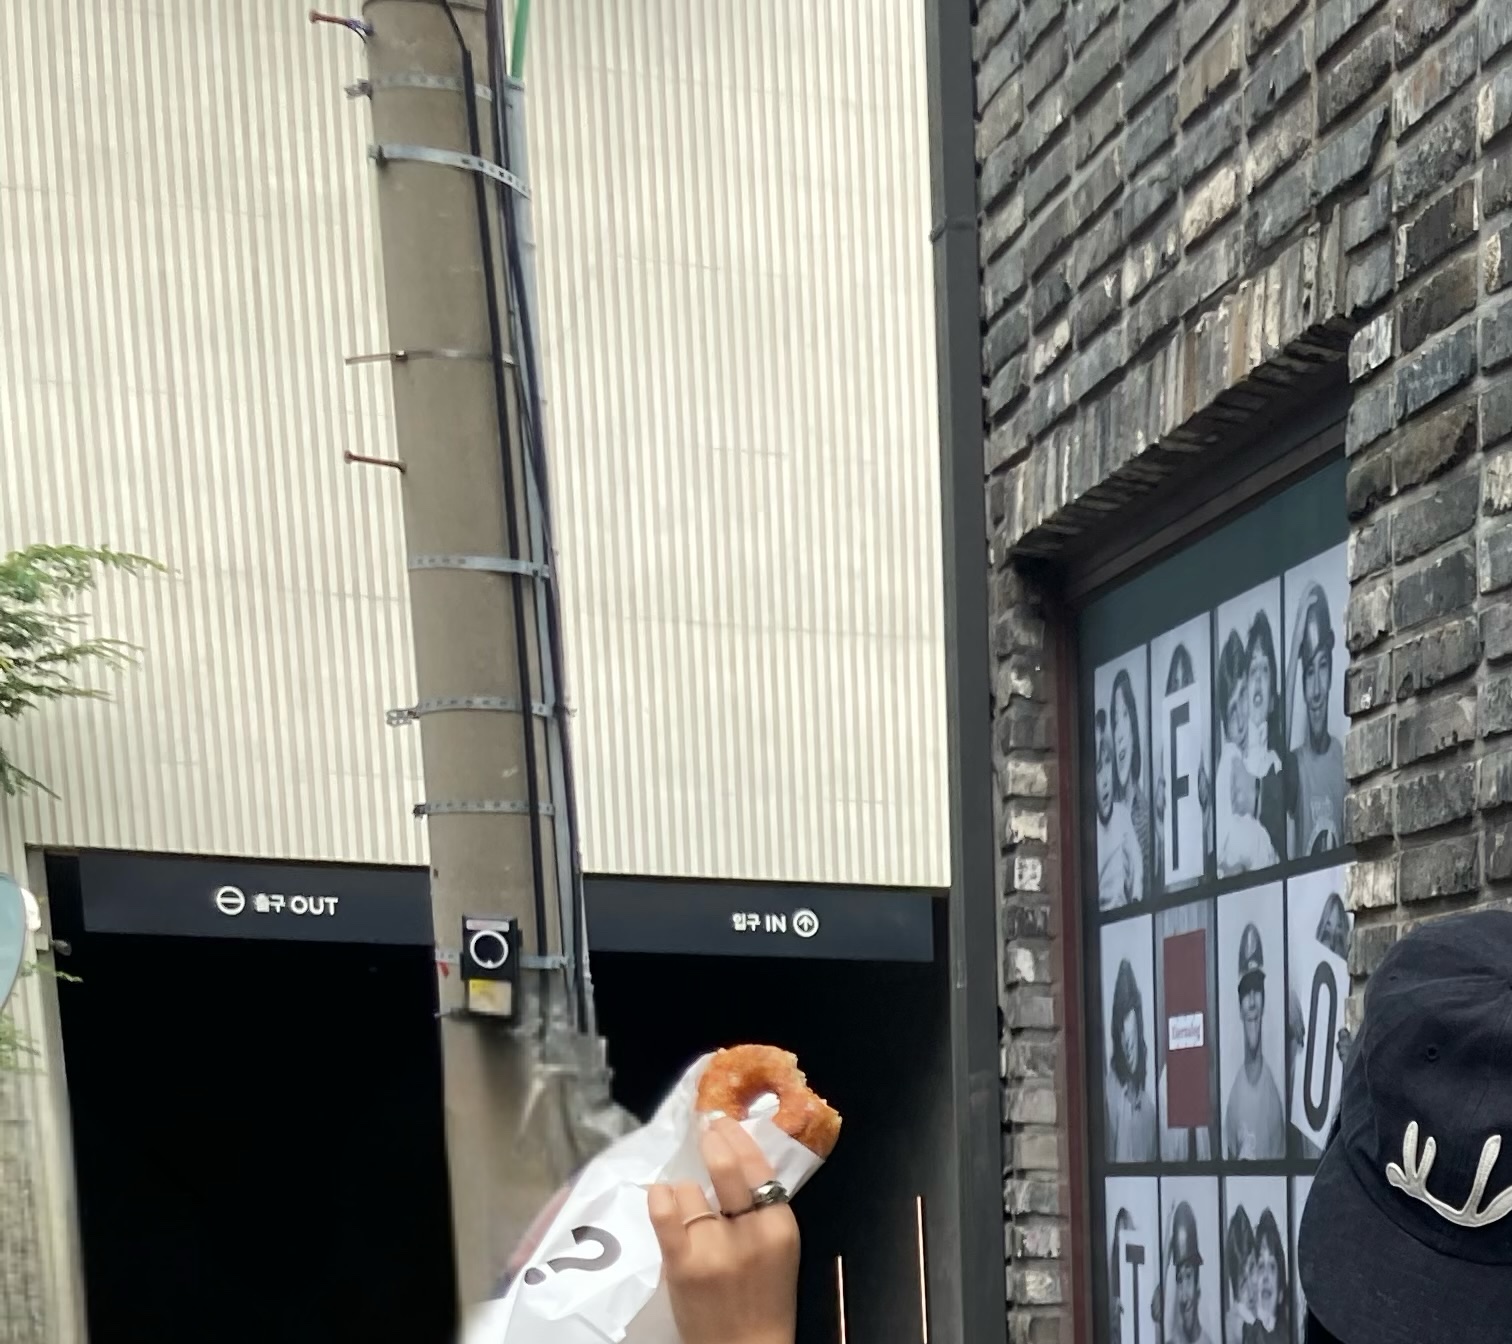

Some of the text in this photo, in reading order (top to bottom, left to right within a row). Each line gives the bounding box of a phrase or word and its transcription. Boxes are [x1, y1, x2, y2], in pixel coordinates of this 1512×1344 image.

[1170, 701, 1190, 871] F
[290, 895, 339, 916] OUT
[732, 912, 787, 933] 입구 IN
[524, 1225, 622, 1286] ?
